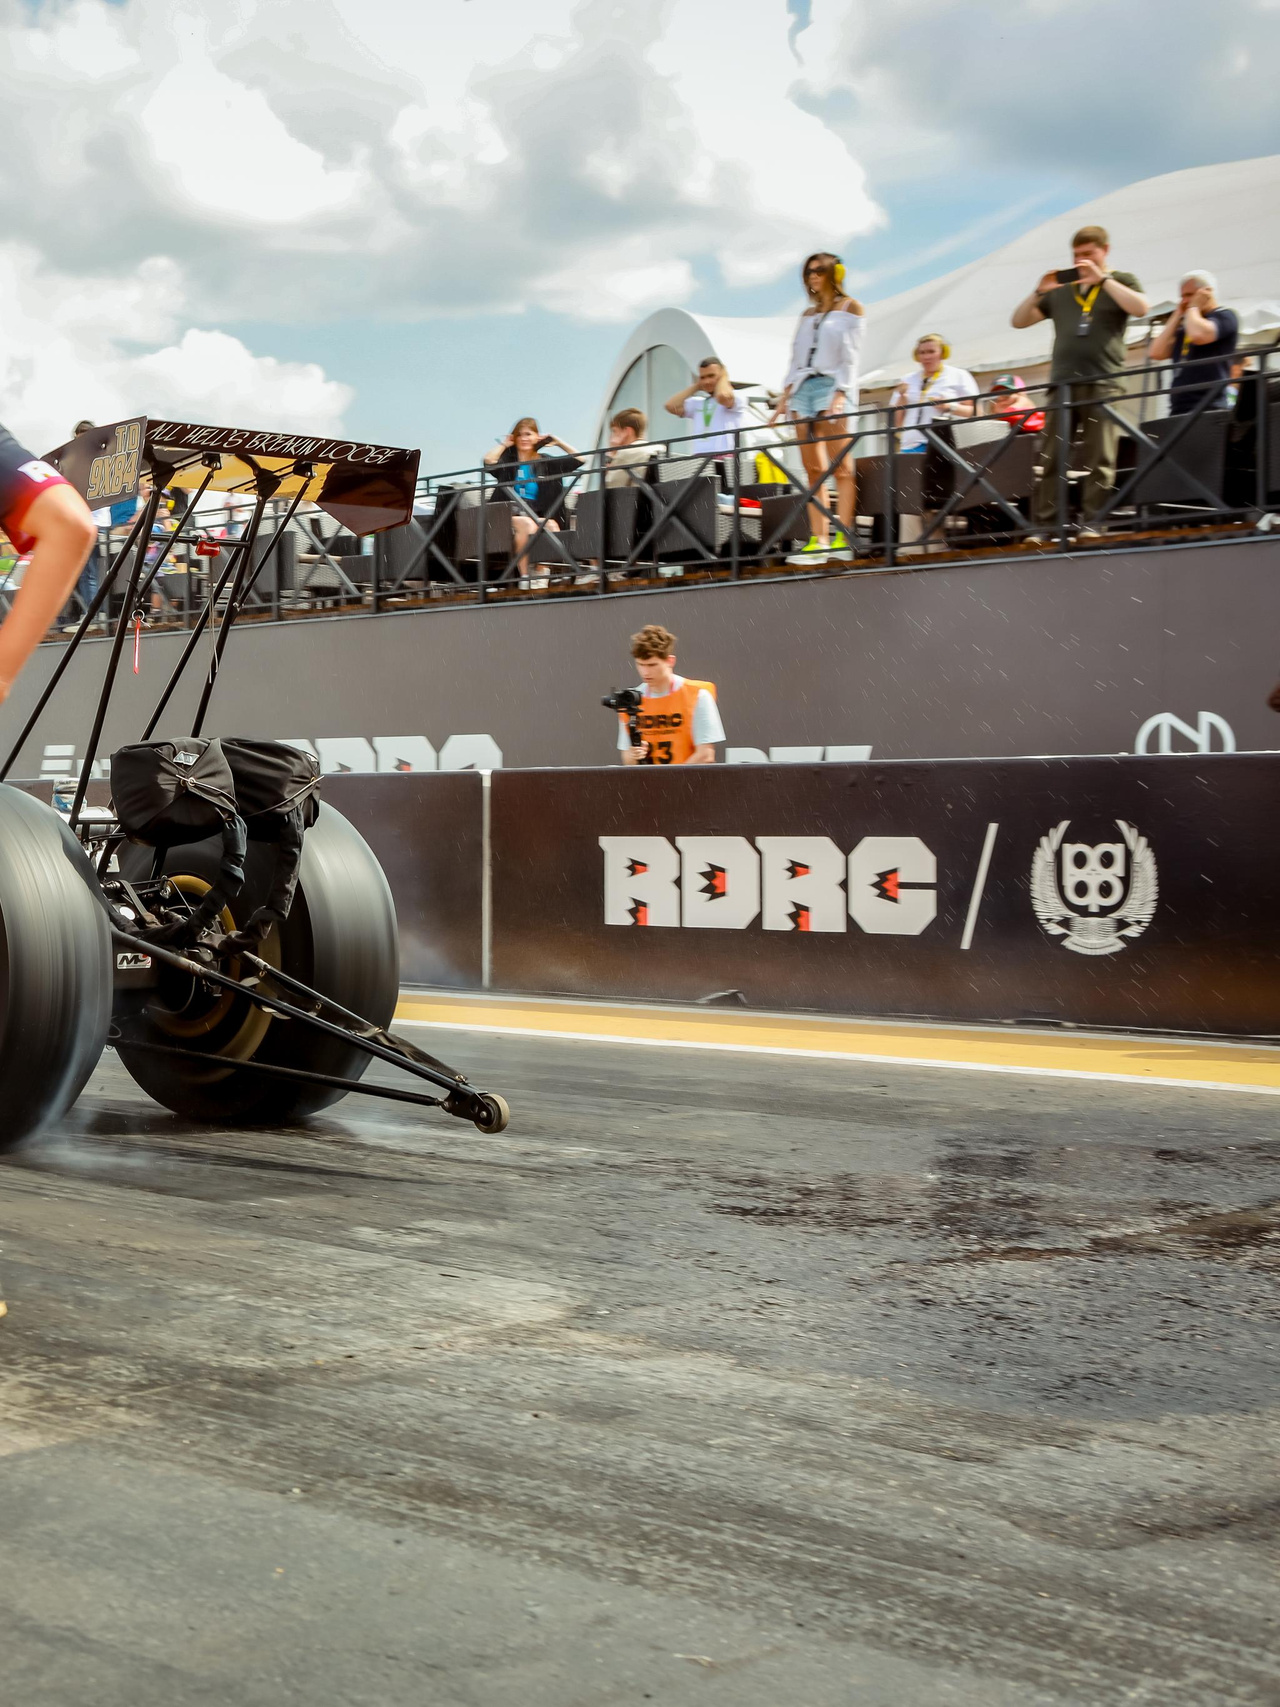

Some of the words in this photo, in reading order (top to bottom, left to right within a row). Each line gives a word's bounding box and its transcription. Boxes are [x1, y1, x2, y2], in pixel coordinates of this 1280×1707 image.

[114, 422, 140, 453] TD
[145, 422, 183, 442] ALL
[318, 442, 402, 465] LOOSE
[86, 450, 140, 500] 9X84
[598, 836, 937, 935] RDRC
